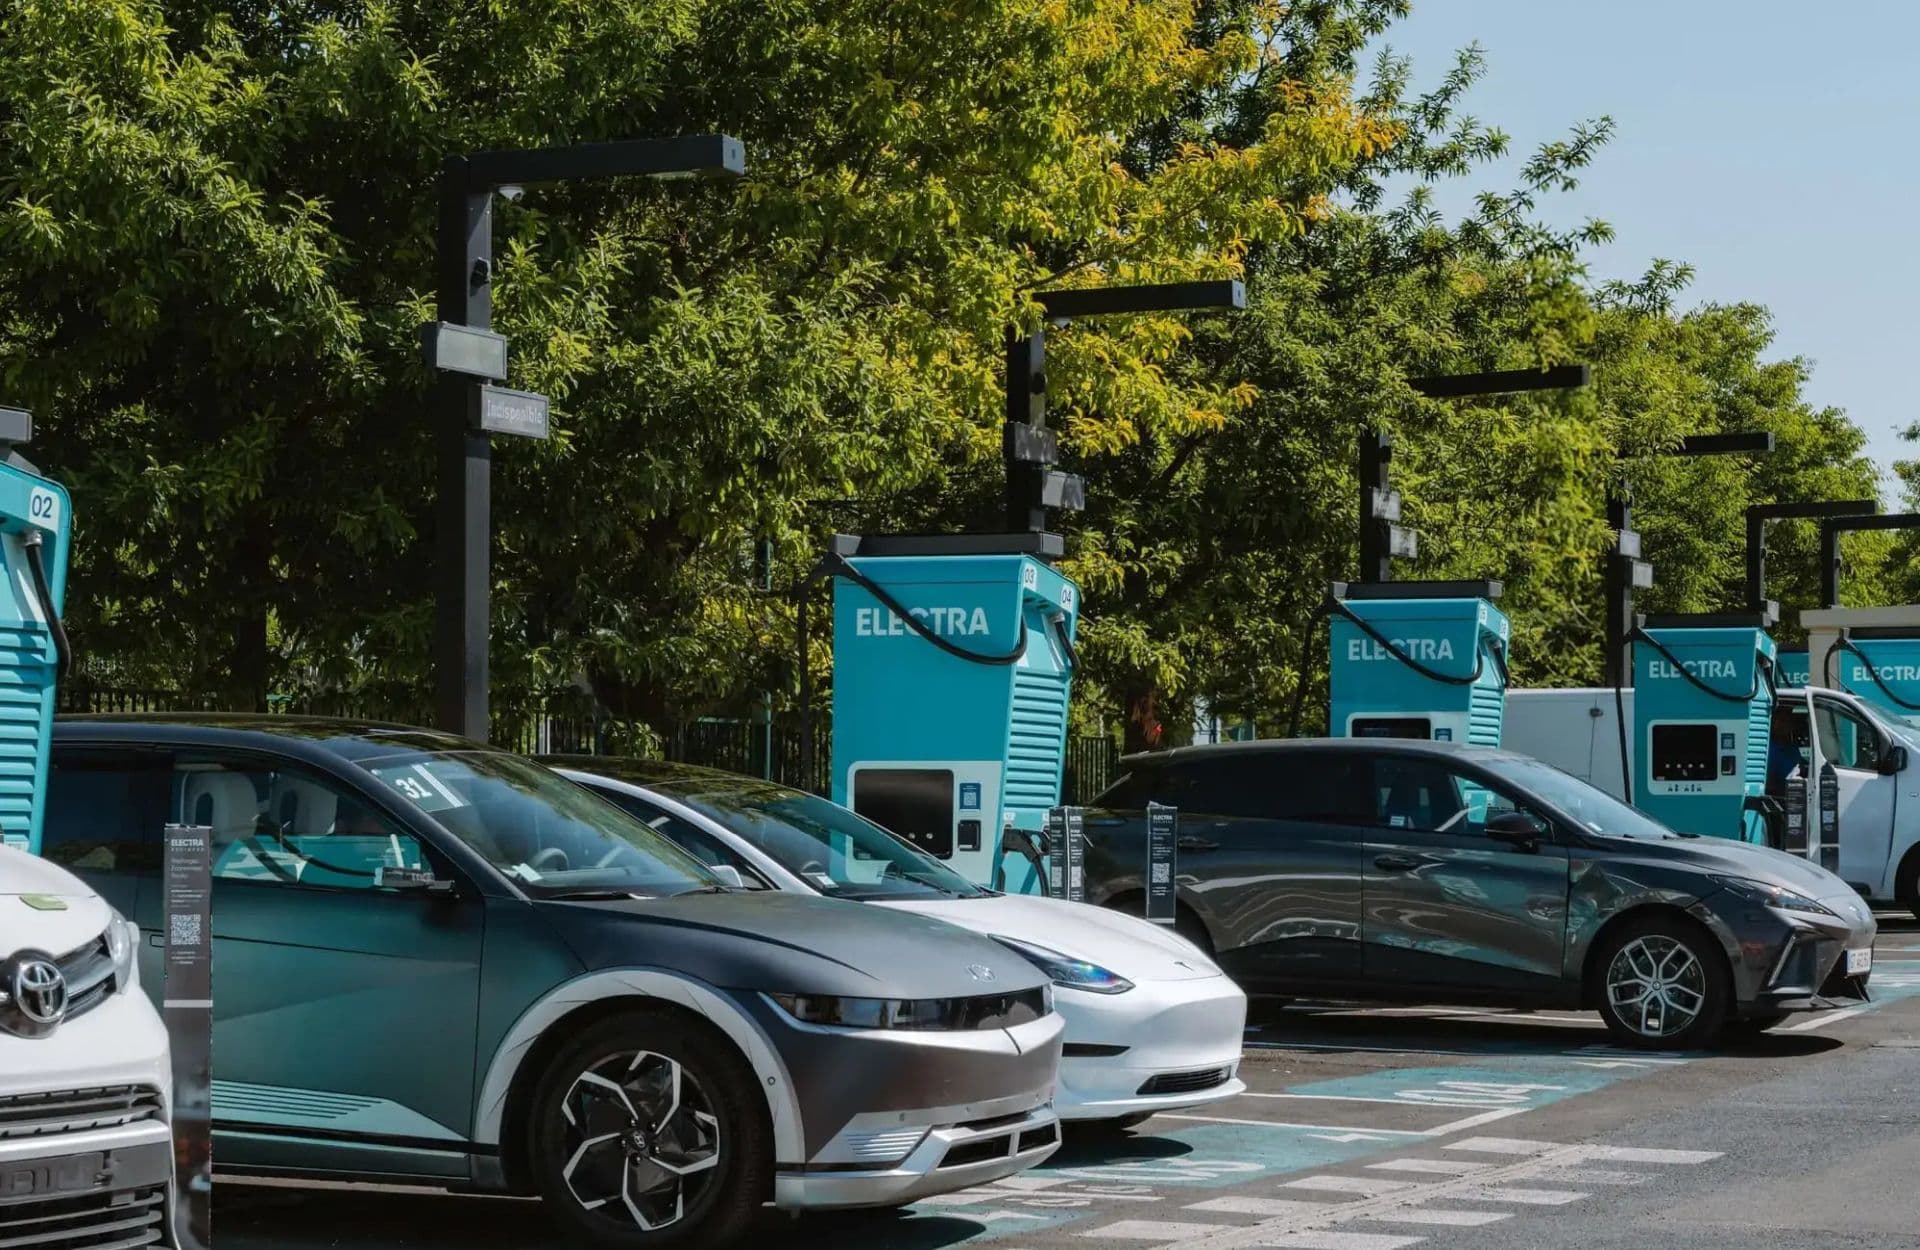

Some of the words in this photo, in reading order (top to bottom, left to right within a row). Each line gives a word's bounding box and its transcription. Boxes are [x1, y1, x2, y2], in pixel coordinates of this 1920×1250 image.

[32, 495, 52, 519] 02
[1024, 568, 1035, 584] 03
[1061, 589, 1072, 604] 04
[395, 777, 433, 799] 31
[171, 838, 204, 847] ELECTRA
